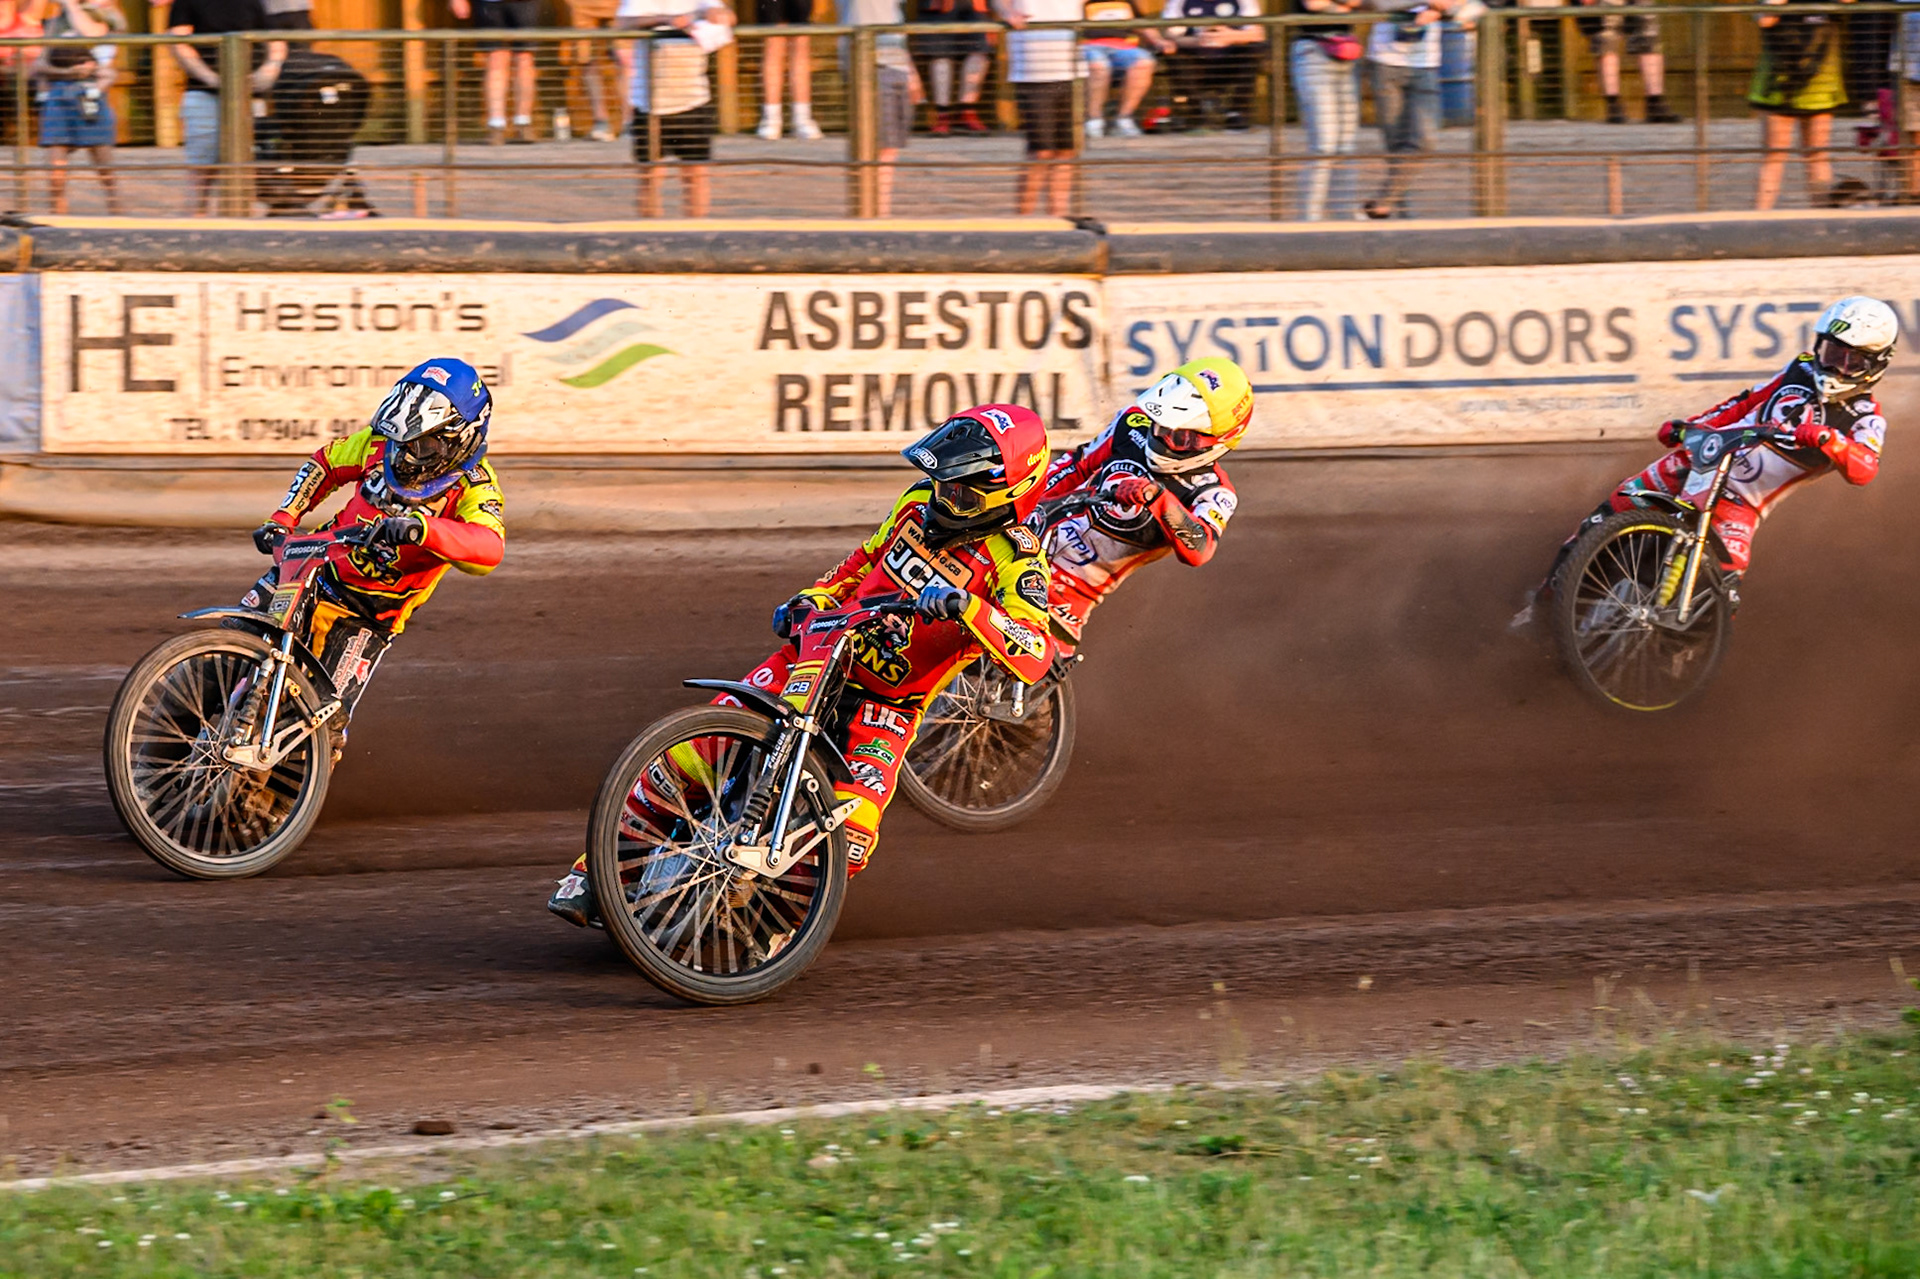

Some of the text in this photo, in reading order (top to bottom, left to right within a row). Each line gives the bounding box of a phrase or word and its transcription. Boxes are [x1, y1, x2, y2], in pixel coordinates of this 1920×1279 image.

[236, 288, 487, 332] Heston's
[757, 290, 1092, 350] ASBESTOS
[1670, 299, 1920, 360] SYSTN
[1127, 308, 1638, 376] SYSTON DOORS
[774, 372, 1081, 432] REMOVAL
[380, 421, 398, 433] BELL
[1110, 460, 1135, 473] BELLE
[1060, 525, 1091, 558] ATPI
[852, 633, 905, 683] ONS
[783, 681, 811, 695] JCB
[880, 751, 895, 764] OIL
